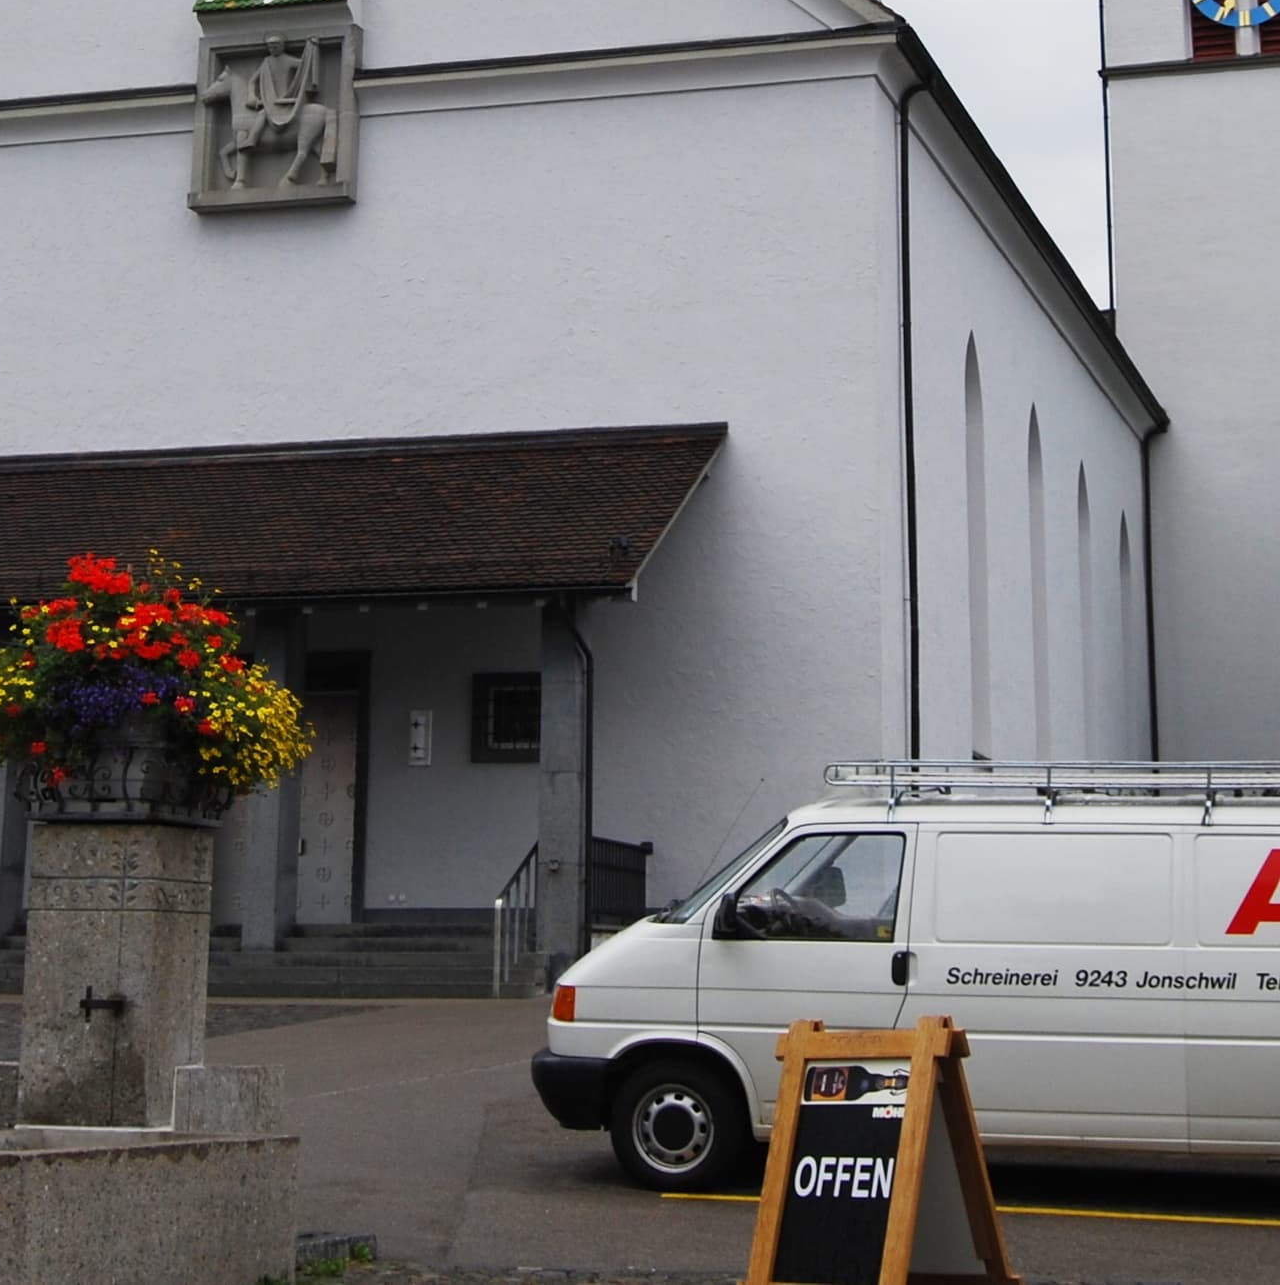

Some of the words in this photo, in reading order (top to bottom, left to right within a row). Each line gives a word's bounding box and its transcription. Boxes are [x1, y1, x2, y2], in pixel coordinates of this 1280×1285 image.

[946, 967, 1059, 987] Schreinerei
[1074, 969, 1128, 988] 9243
[1136, 971, 1238, 990] Jonschwil
[794, 1156, 895, 1199] OFFEN
